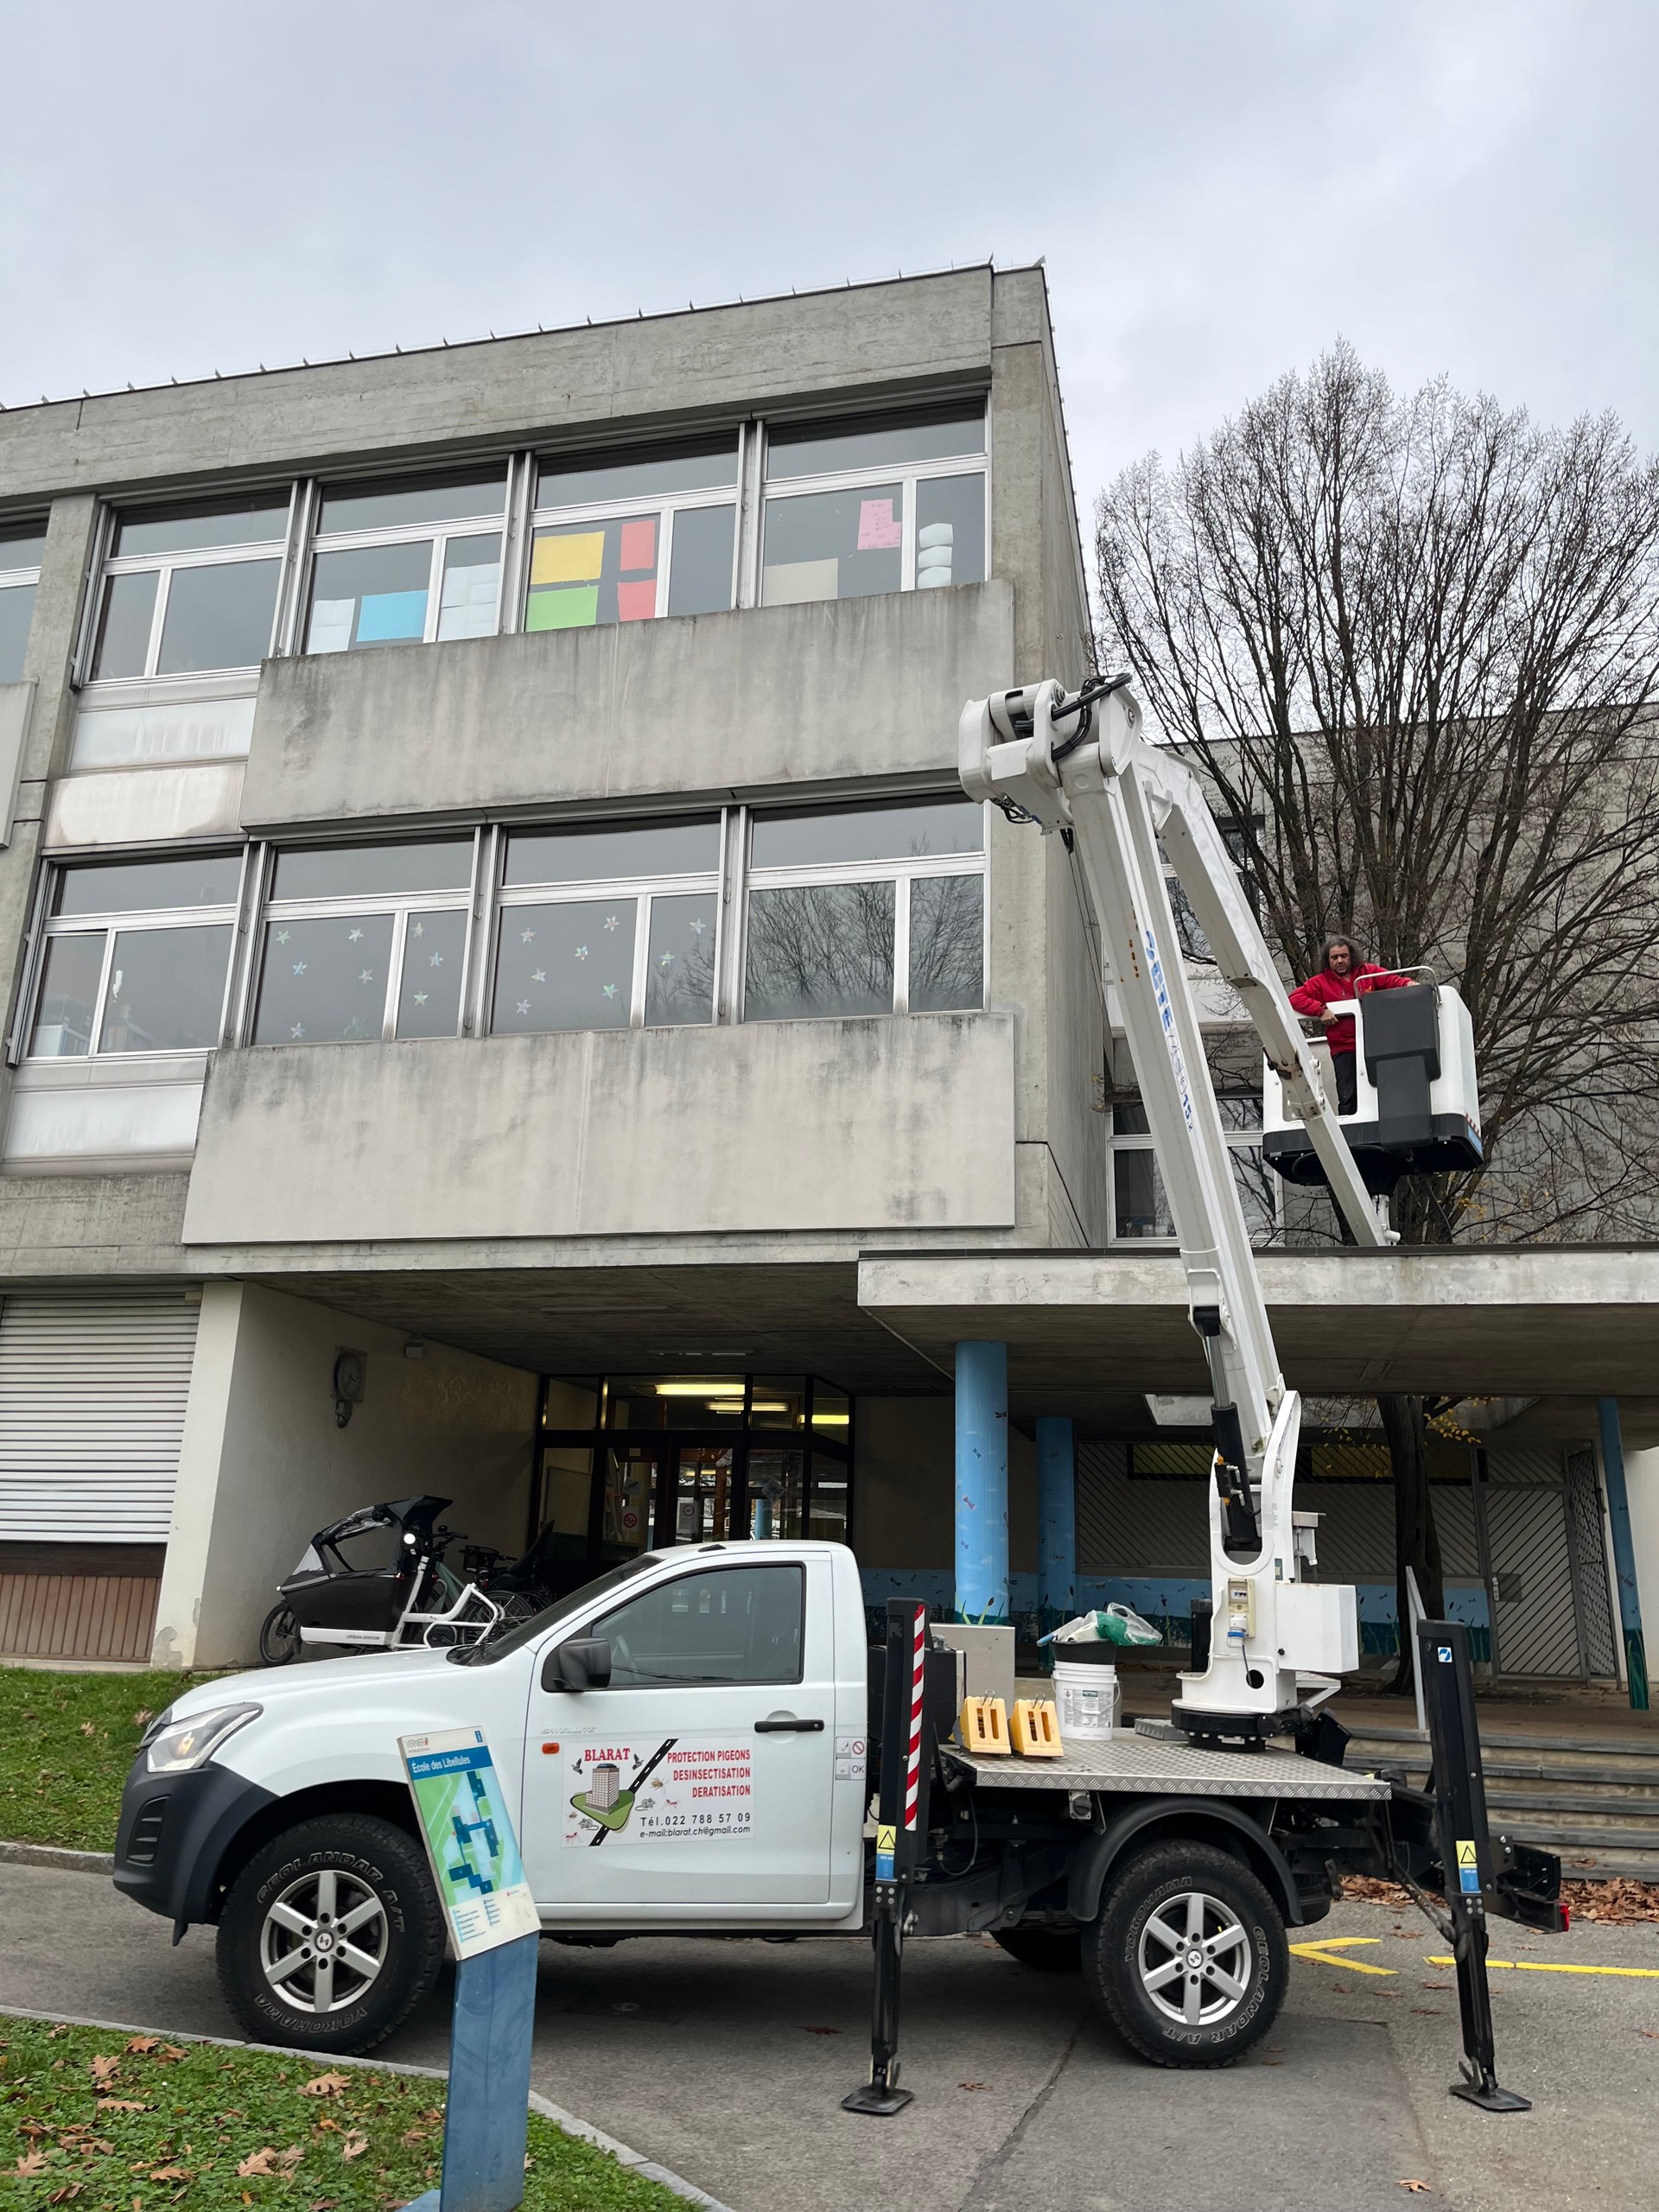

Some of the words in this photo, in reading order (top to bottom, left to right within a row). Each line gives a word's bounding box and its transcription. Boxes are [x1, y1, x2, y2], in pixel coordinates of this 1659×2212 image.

[1151, 960, 1173, 1033] CTE
[584, 1747, 631, 1762] BLARAT
[667, 1751, 715, 1764] PROTECTION
[717, 1749, 751, 1761] PIGEONS
[411, 1761, 431, 1773] École
[431, 1760, 443, 1770] des
[442, 1755, 471, 1768] Libellules
[852, 1764, 865, 1773] OK
[673, 1767, 751, 1781] DESINSECTISATION
[692, 1784, 751, 1798] DERATISATION
[692, 1815, 713, 1825] 788
[718, 1813, 732, 1823] 57
[737, 1812, 751, 1822] 09
[639, 1825, 751, 1838] e-mail:blarat.ch@gmail.com
[256, 1851, 385, 1905] GEOLANDAR
[1124, 1876, 1194, 1963] YOKOHAMA
[1211, 1925, 1271, 2044] GEOLANDAR
[254, 1992, 369, 2035] YOKOHAMA
[1162, 2022, 1204, 2045] A/T
